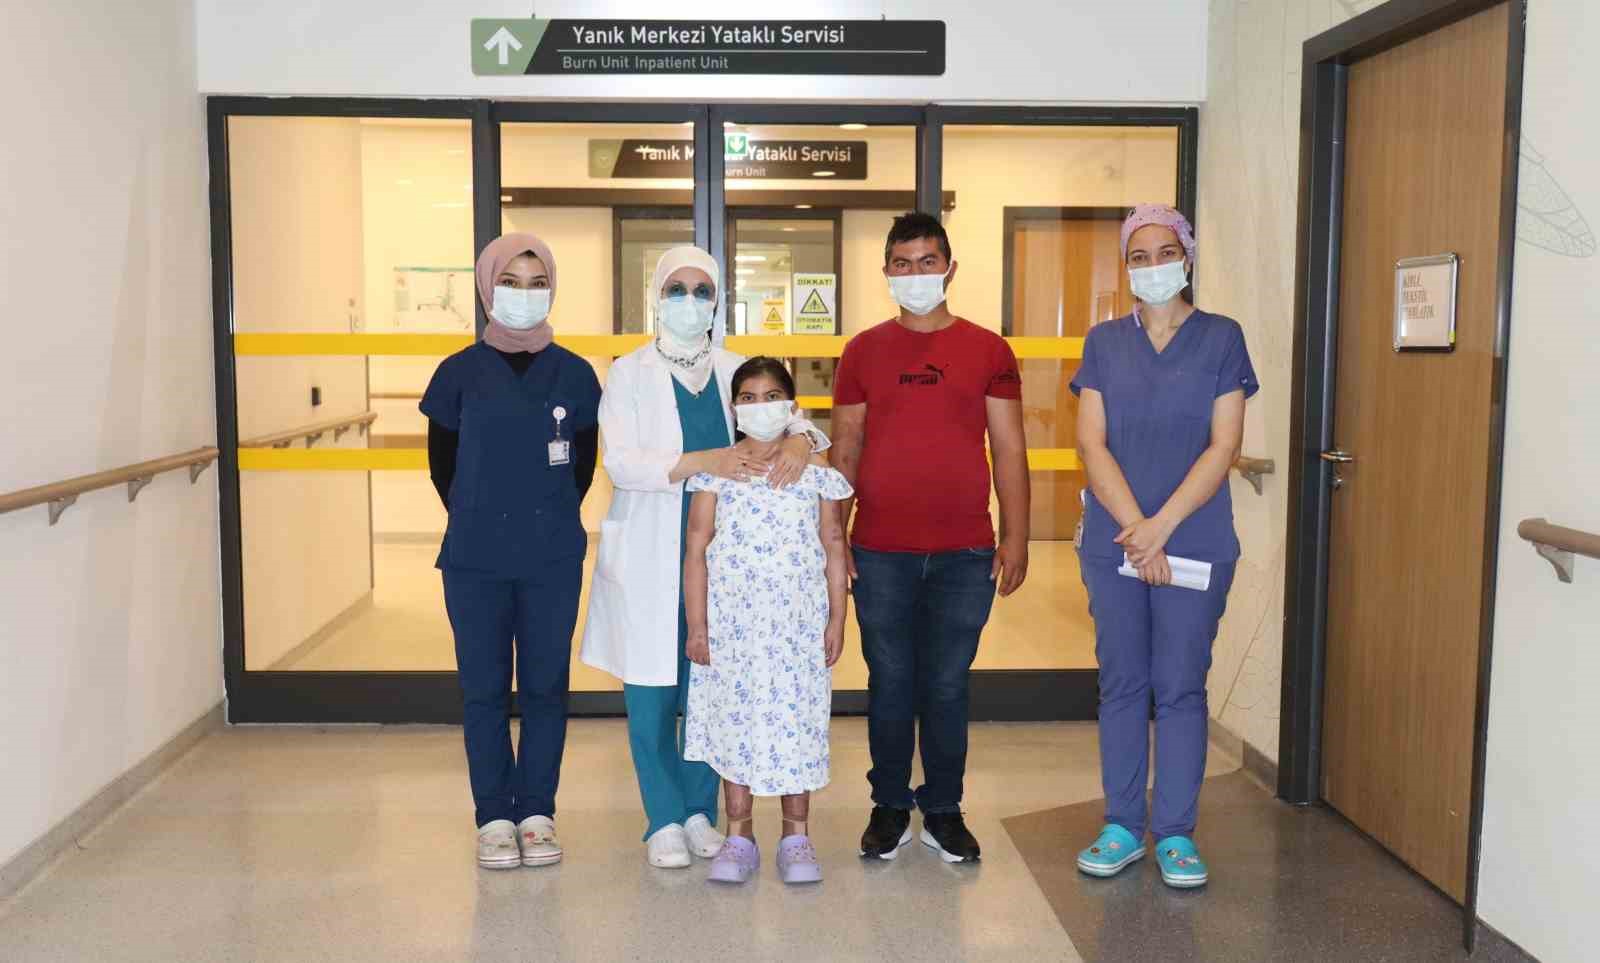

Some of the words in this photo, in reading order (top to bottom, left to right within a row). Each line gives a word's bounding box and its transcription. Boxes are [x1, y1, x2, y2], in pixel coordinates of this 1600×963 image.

[572, 25, 625, 44] Yanık
[630, 25, 706, 44] Merkezi
[711, 25, 776, 43] Yataklı
[780, 25, 844, 43] Servisi
[562, 55, 597, 69] Burn
[601, 55, 630, 69] Unit
[634, 55, 697, 71] Inpatient
[700, 55, 729, 69] Unit
[639, 144, 680, 161] Yanık
[747, 145, 798, 161] Yataklı
[800, 146, 851, 161] Servisi
